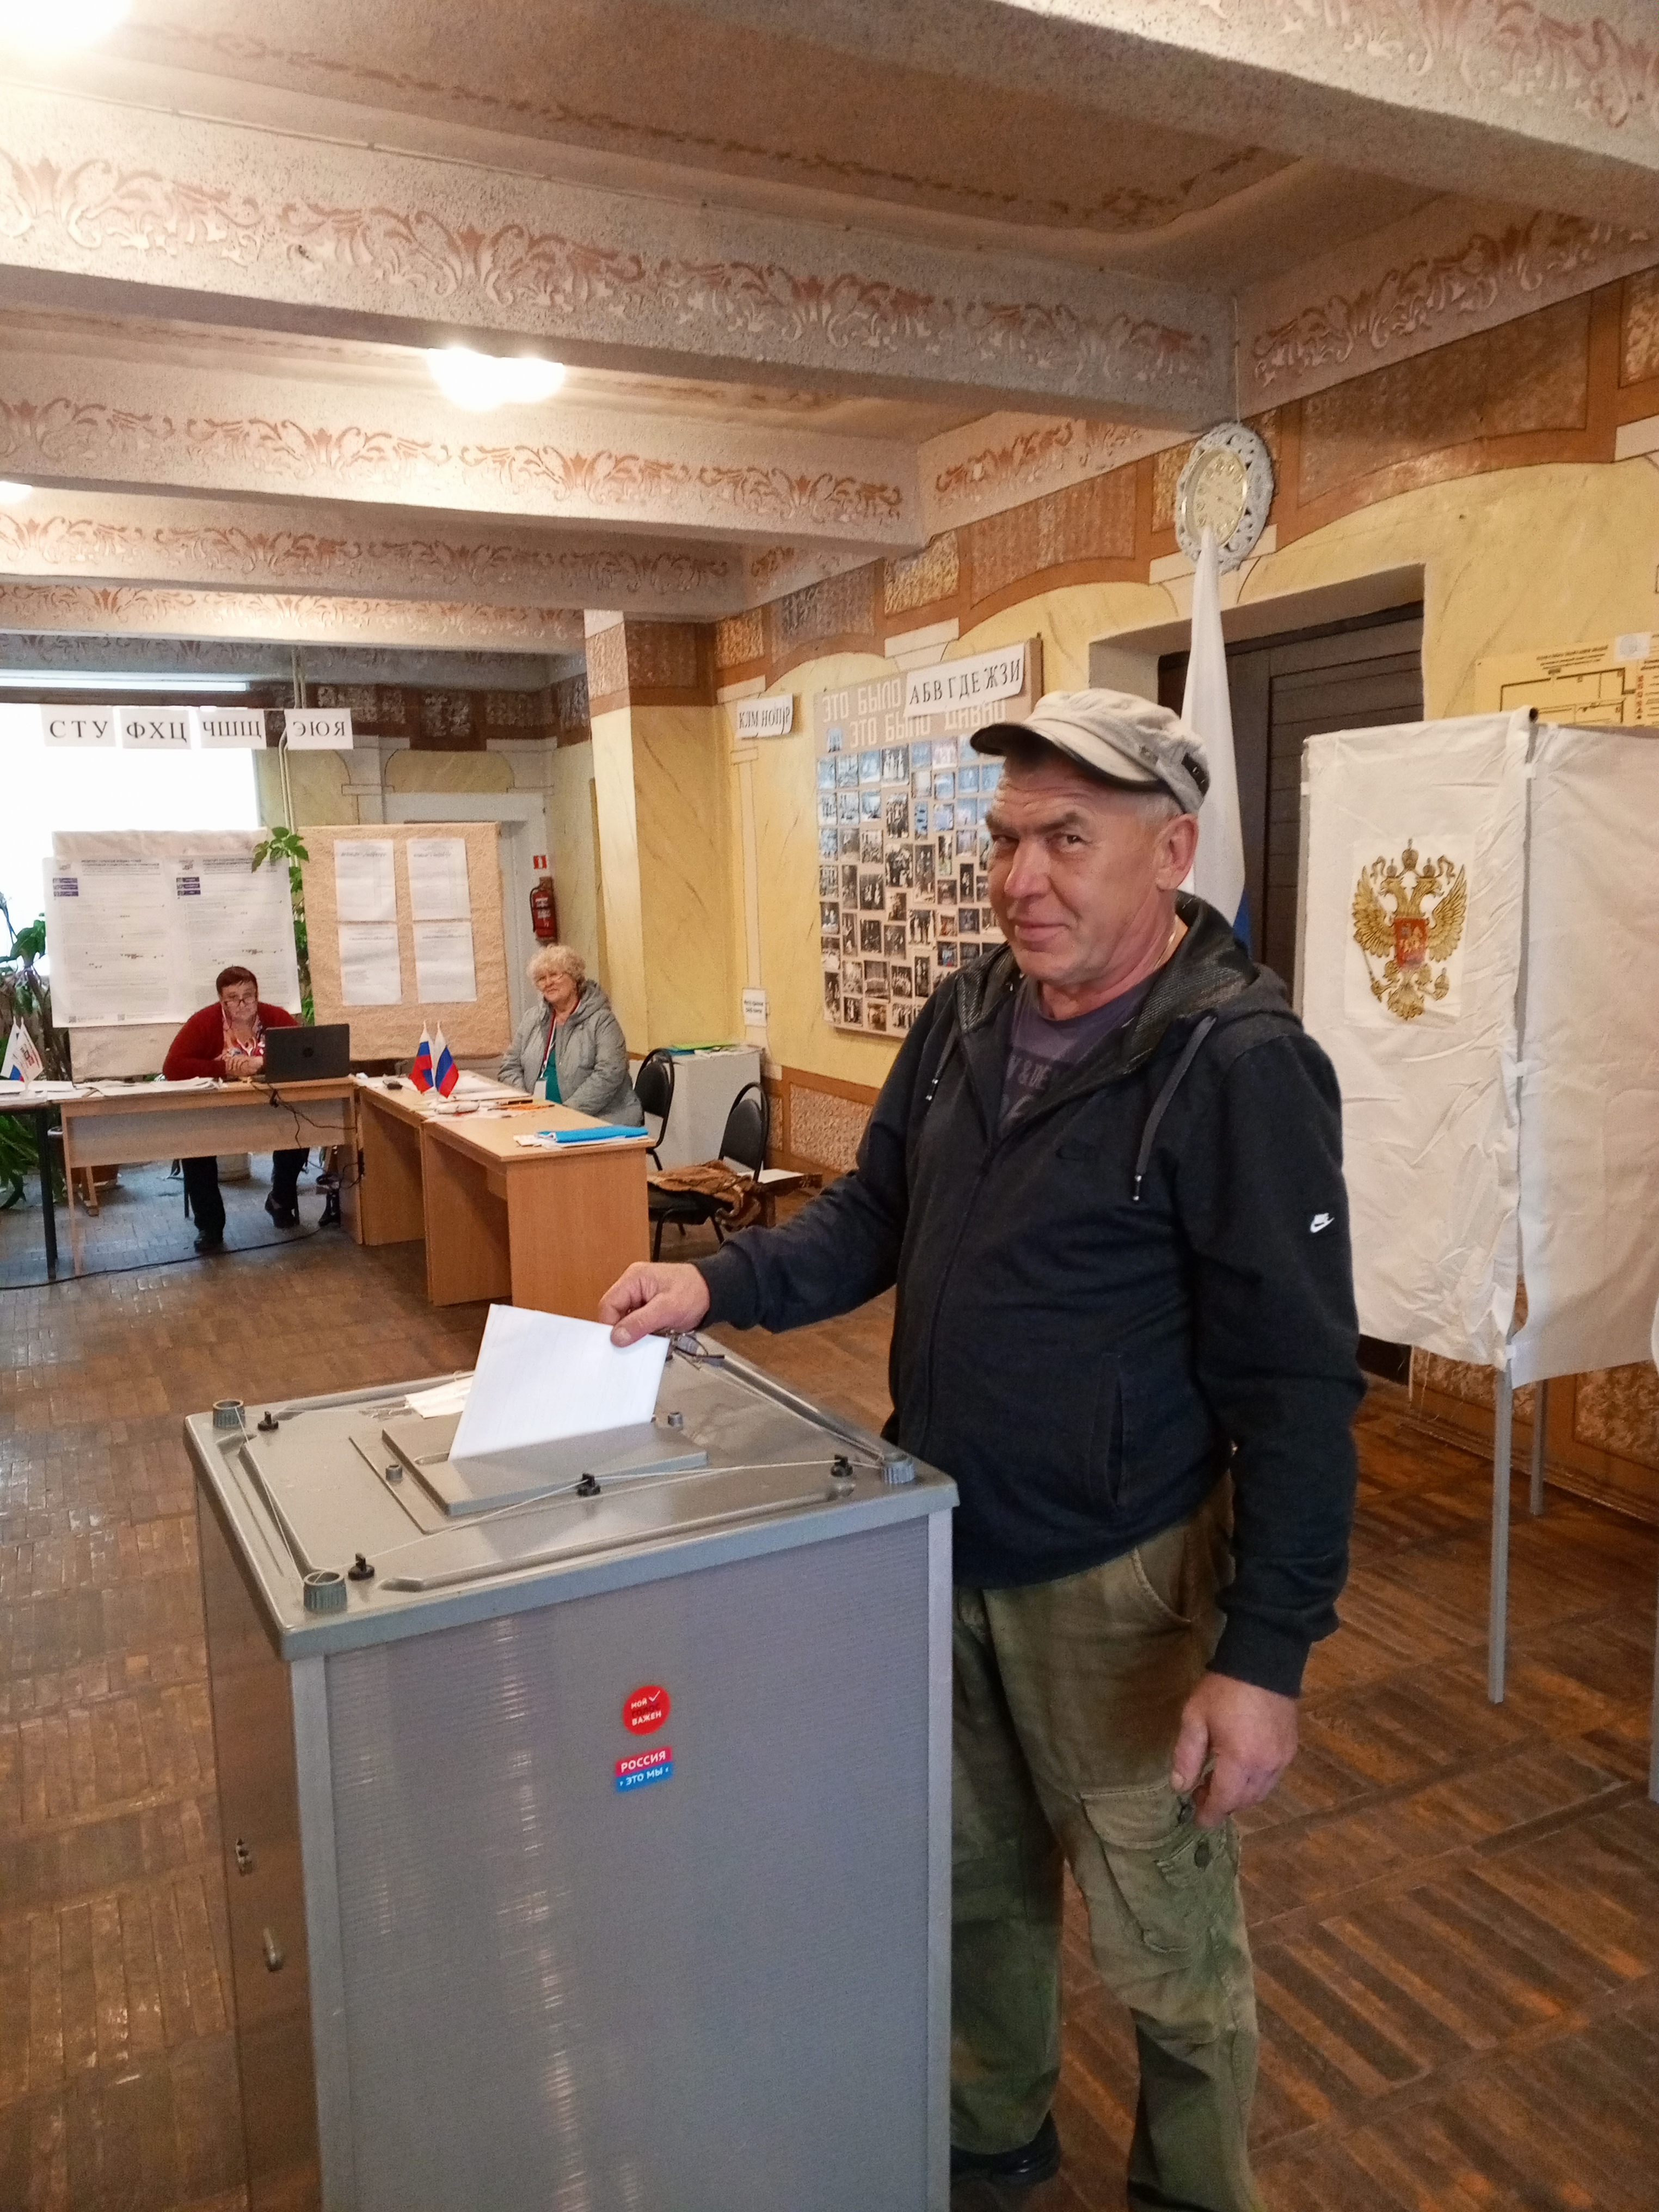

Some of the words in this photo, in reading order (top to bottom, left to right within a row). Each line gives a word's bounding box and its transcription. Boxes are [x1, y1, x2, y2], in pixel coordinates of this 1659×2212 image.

[822, 691, 849, 723] ЭТО
[858, 679, 901, 716] БЫЛО
[50, 720, 107, 738] СТУ
[126, 722, 187, 743] ФХЦ
[202, 721, 262, 739] ЧШЩ
[293, 721, 345, 736] ЭЮЯ
[850, 717, 877, 748] ЭТО
[632, 1710, 662, 1726] ВАЖЕН
[621, 1750, 666, 1773] РОССИЯ
[626, 1773, 644, 1786] ЭТО
[647, 1767, 663, 1780] МЫ
